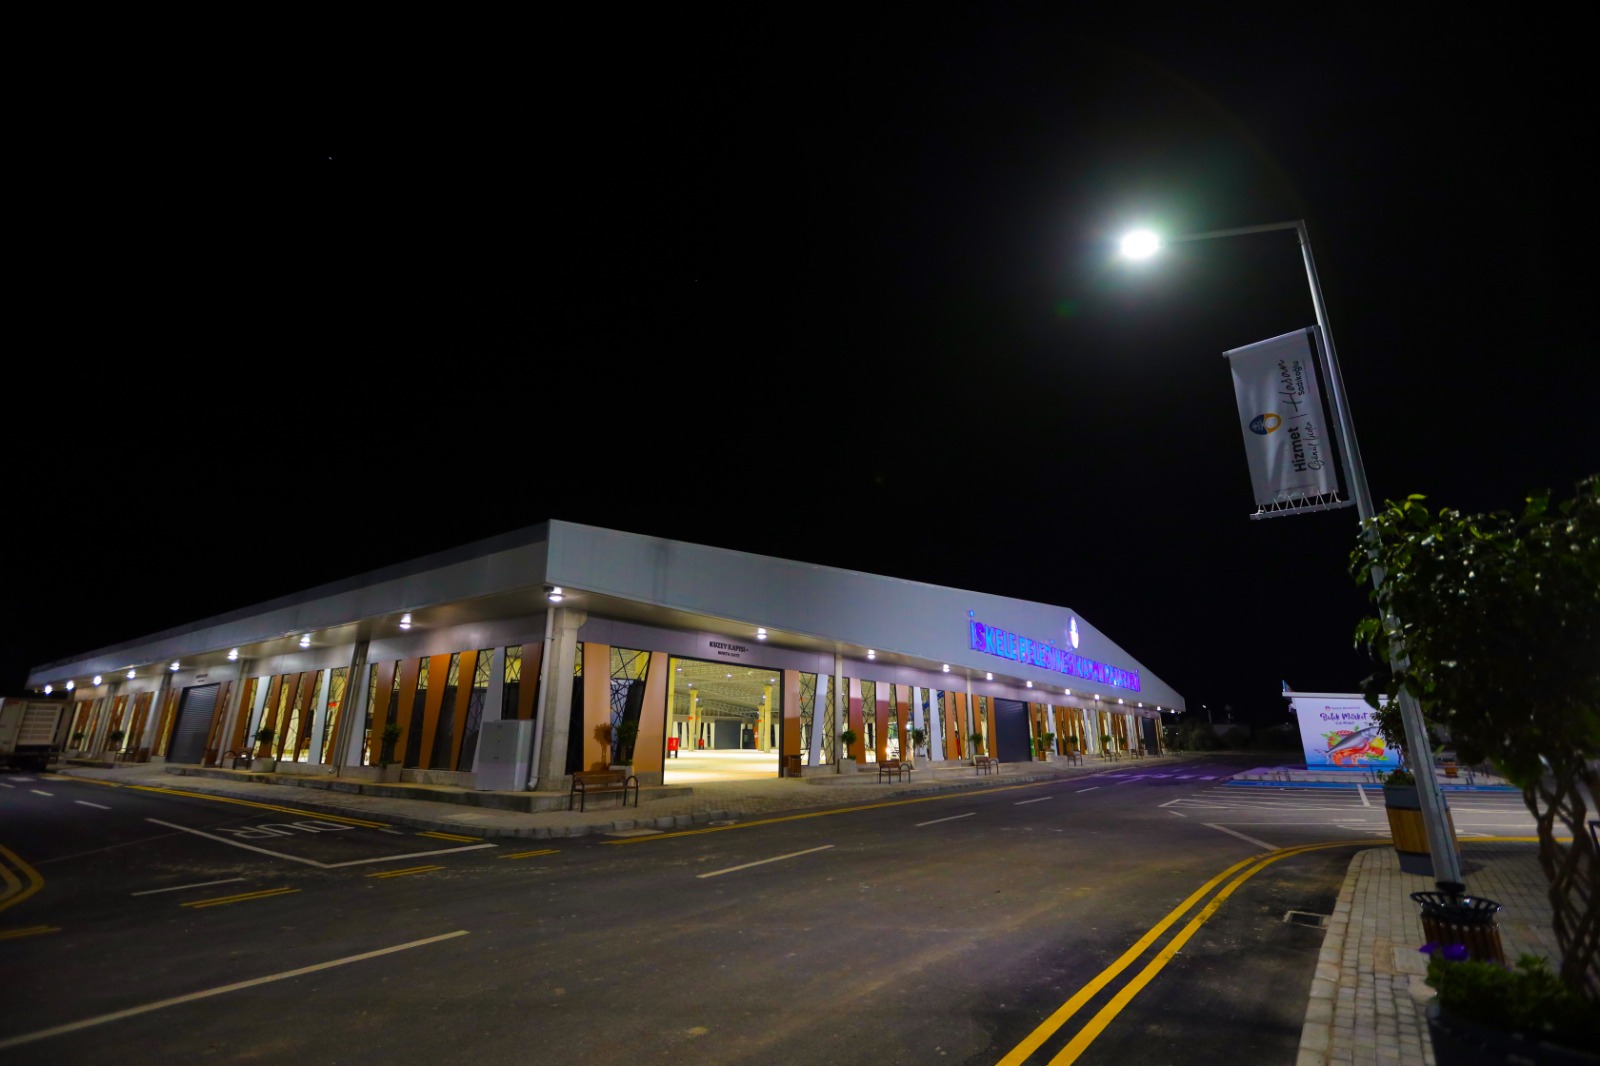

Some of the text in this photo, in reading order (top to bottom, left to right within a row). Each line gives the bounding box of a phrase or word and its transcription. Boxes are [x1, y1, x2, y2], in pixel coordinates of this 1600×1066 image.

[1278, 359, 1303, 413] Hasan
[1287, 426, 1307, 473] Hizmet
[709, 641, 727, 650] KUZEY
[727, 644, 746, 653] KAPISI
[968, 610, 1017, 661] İSKELE
[1342, 712, 1368, 720] Market
[216, 820, 356, 838] DUR
